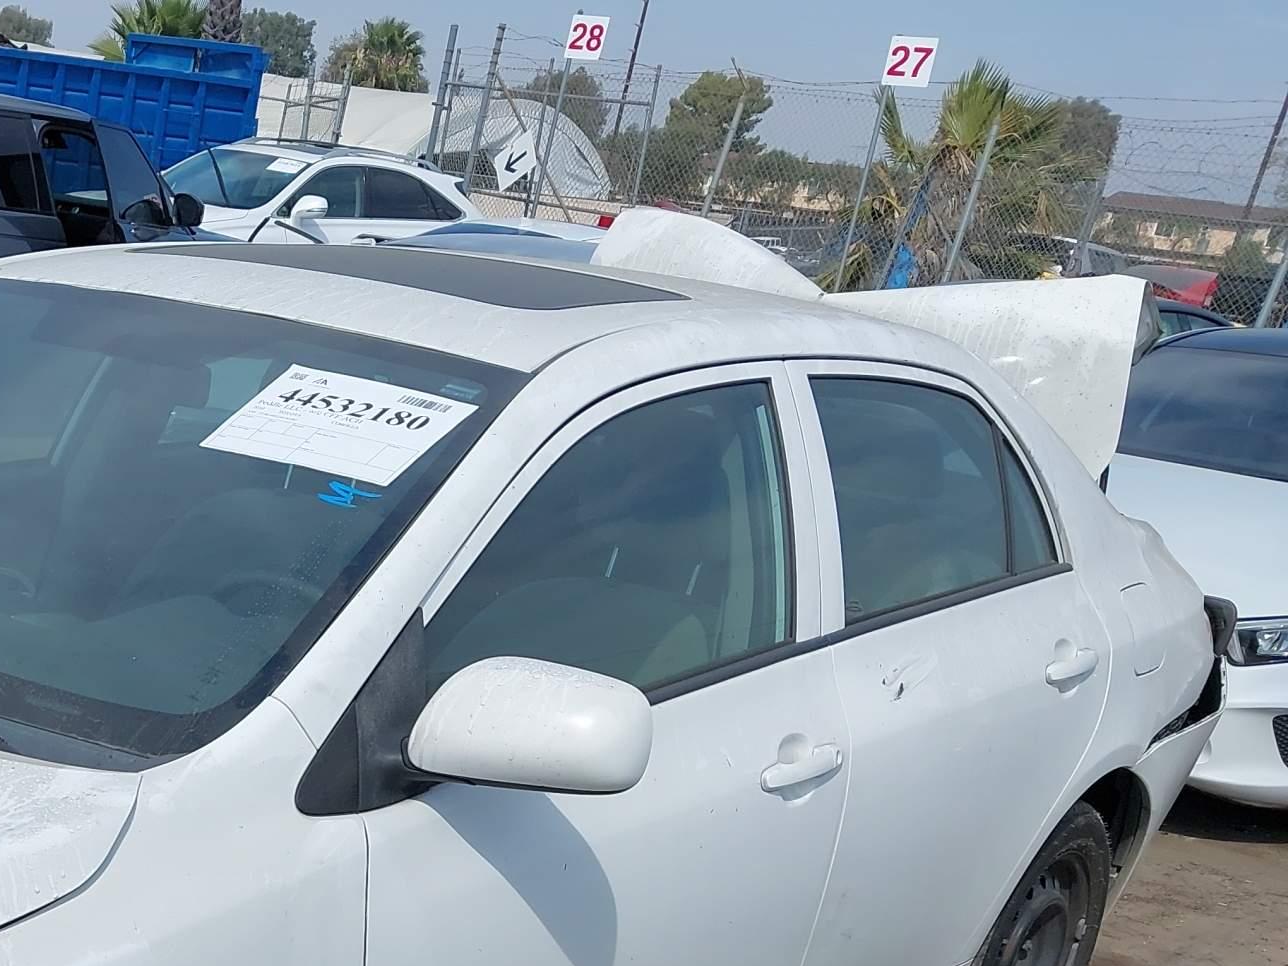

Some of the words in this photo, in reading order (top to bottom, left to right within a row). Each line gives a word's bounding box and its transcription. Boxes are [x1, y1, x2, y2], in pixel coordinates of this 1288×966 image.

[568, 22, 604, 52] 28
[886, 45, 934, 78] 27
[278, 388, 431, 430] 44532180
